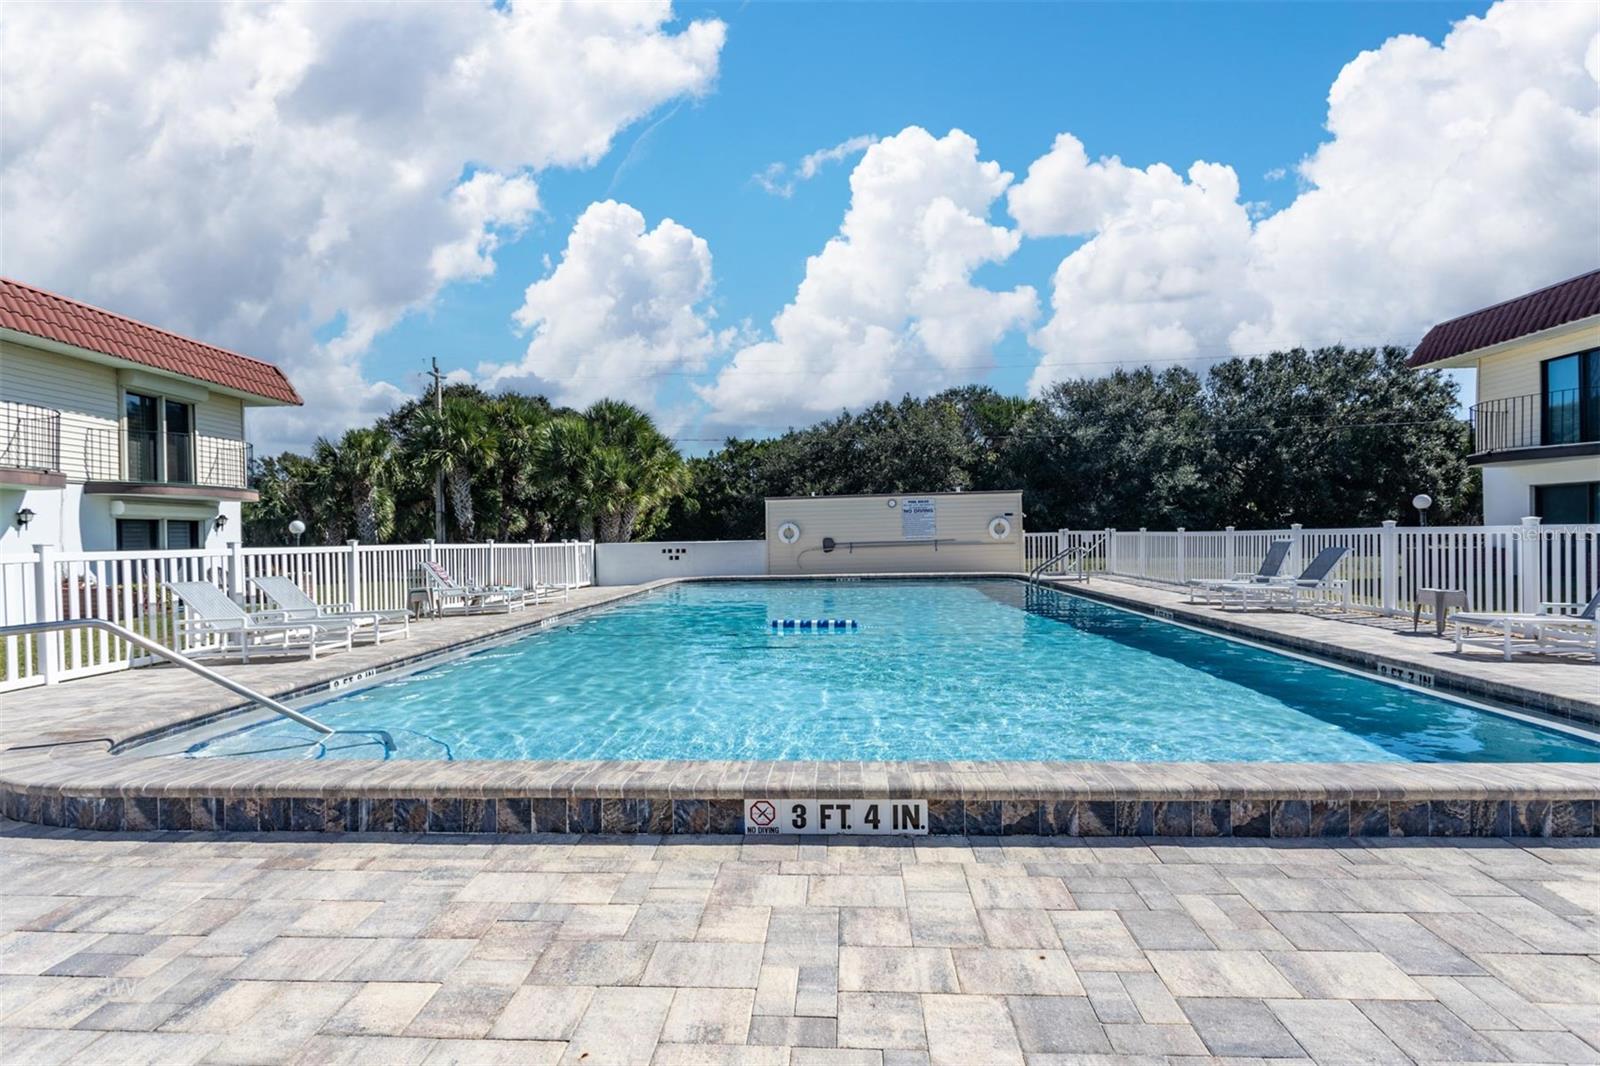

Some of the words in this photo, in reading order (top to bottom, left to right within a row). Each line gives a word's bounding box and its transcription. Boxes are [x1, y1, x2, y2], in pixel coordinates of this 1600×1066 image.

[791, 804, 807, 829] 3
[819, 804, 852, 830] FT.
[864, 804, 881, 830] 4
[892, 804, 926, 830] IN.
[747, 826, 757, 834] NO
[757, 826, 780, 834] DIVING
